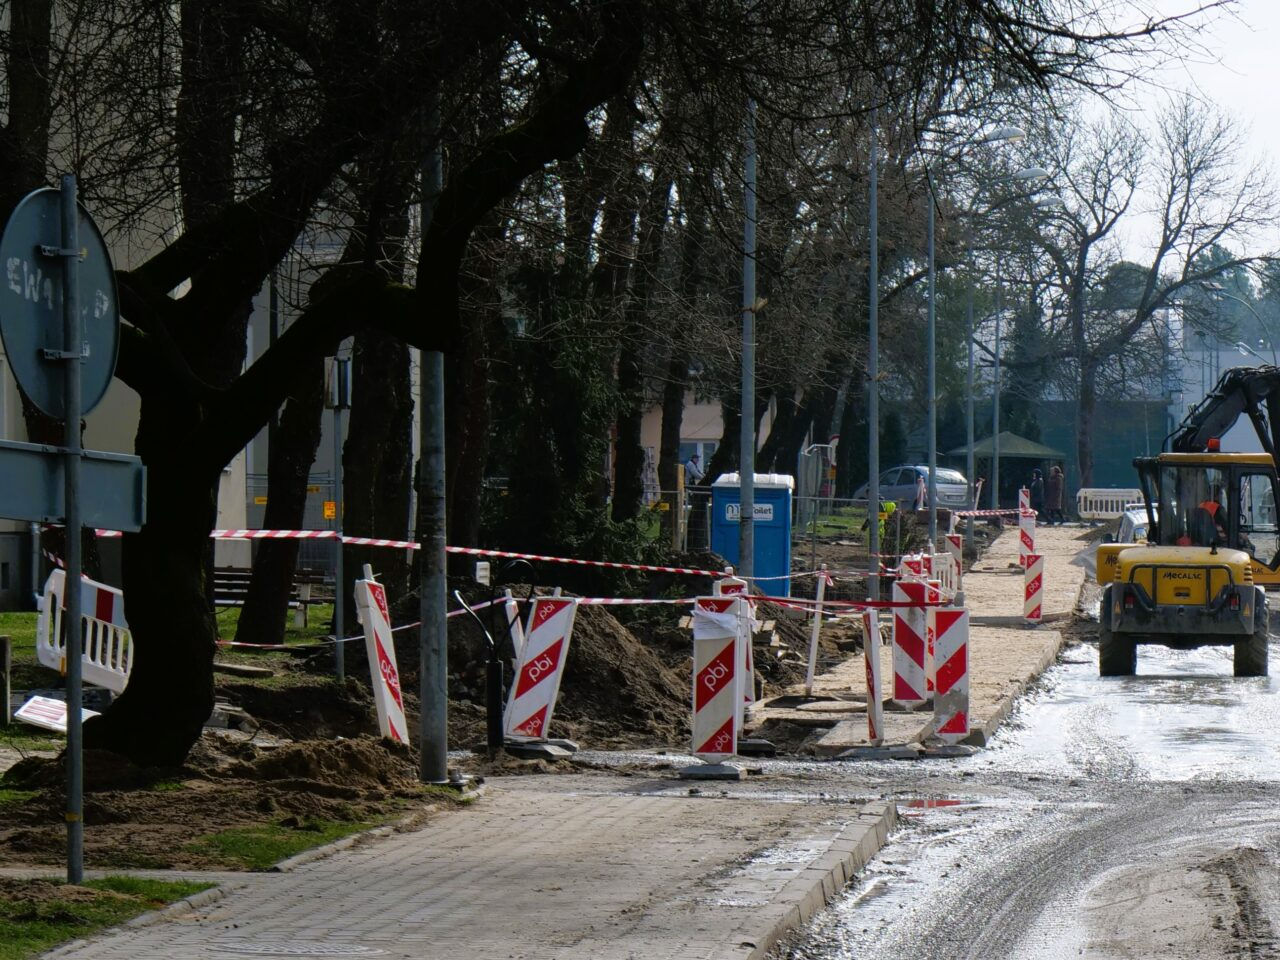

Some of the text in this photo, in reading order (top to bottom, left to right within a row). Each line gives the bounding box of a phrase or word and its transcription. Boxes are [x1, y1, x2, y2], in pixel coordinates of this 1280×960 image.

[539, 602, 555, 620] pbi
[528, 656, 553, 682] pbi
[704, 660, 729, 692] pbi
[525, 718, 542, 735] pbi
[714, 730, 732, 751] pbi
